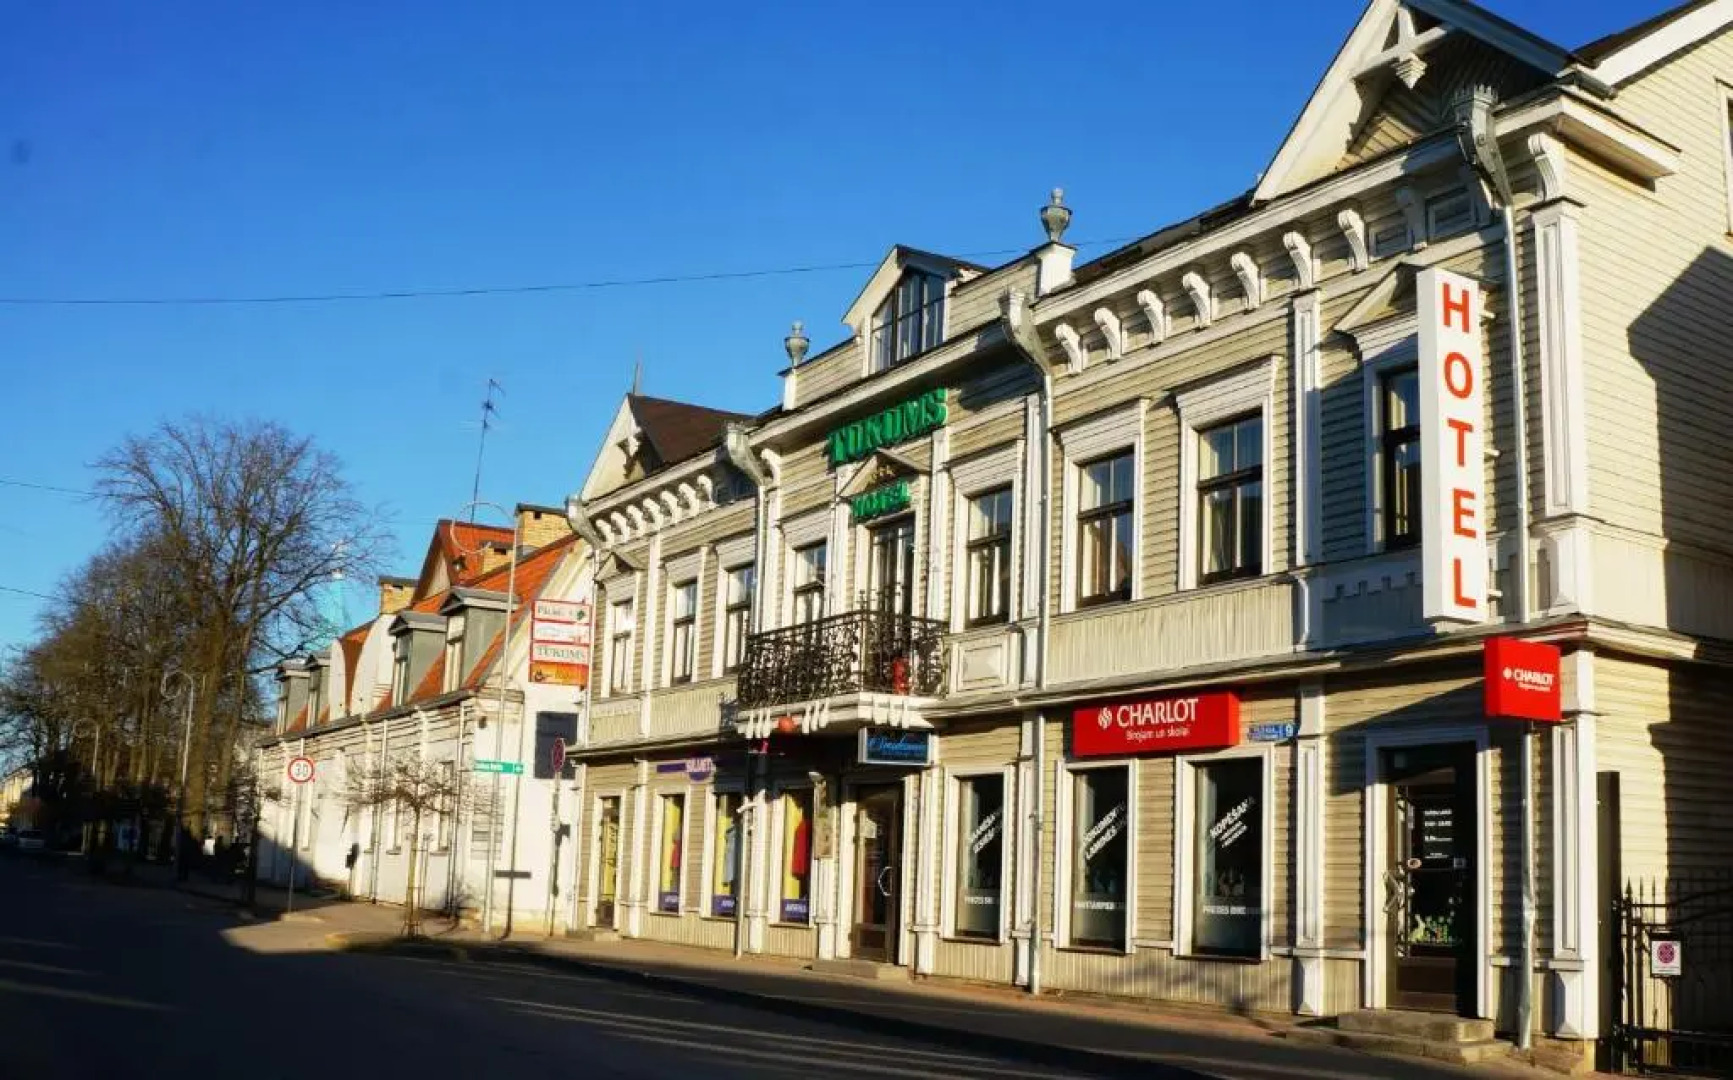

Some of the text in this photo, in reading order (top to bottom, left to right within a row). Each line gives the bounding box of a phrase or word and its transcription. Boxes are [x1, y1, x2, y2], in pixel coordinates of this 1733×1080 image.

[827, 388, 948, 464] TUKUMS
[1441, 282, 1477, 609] HOTEL
[1515, 668, 1555, 686] CHARLOT
[1116, 697, 1199, 729] CHARLOT
